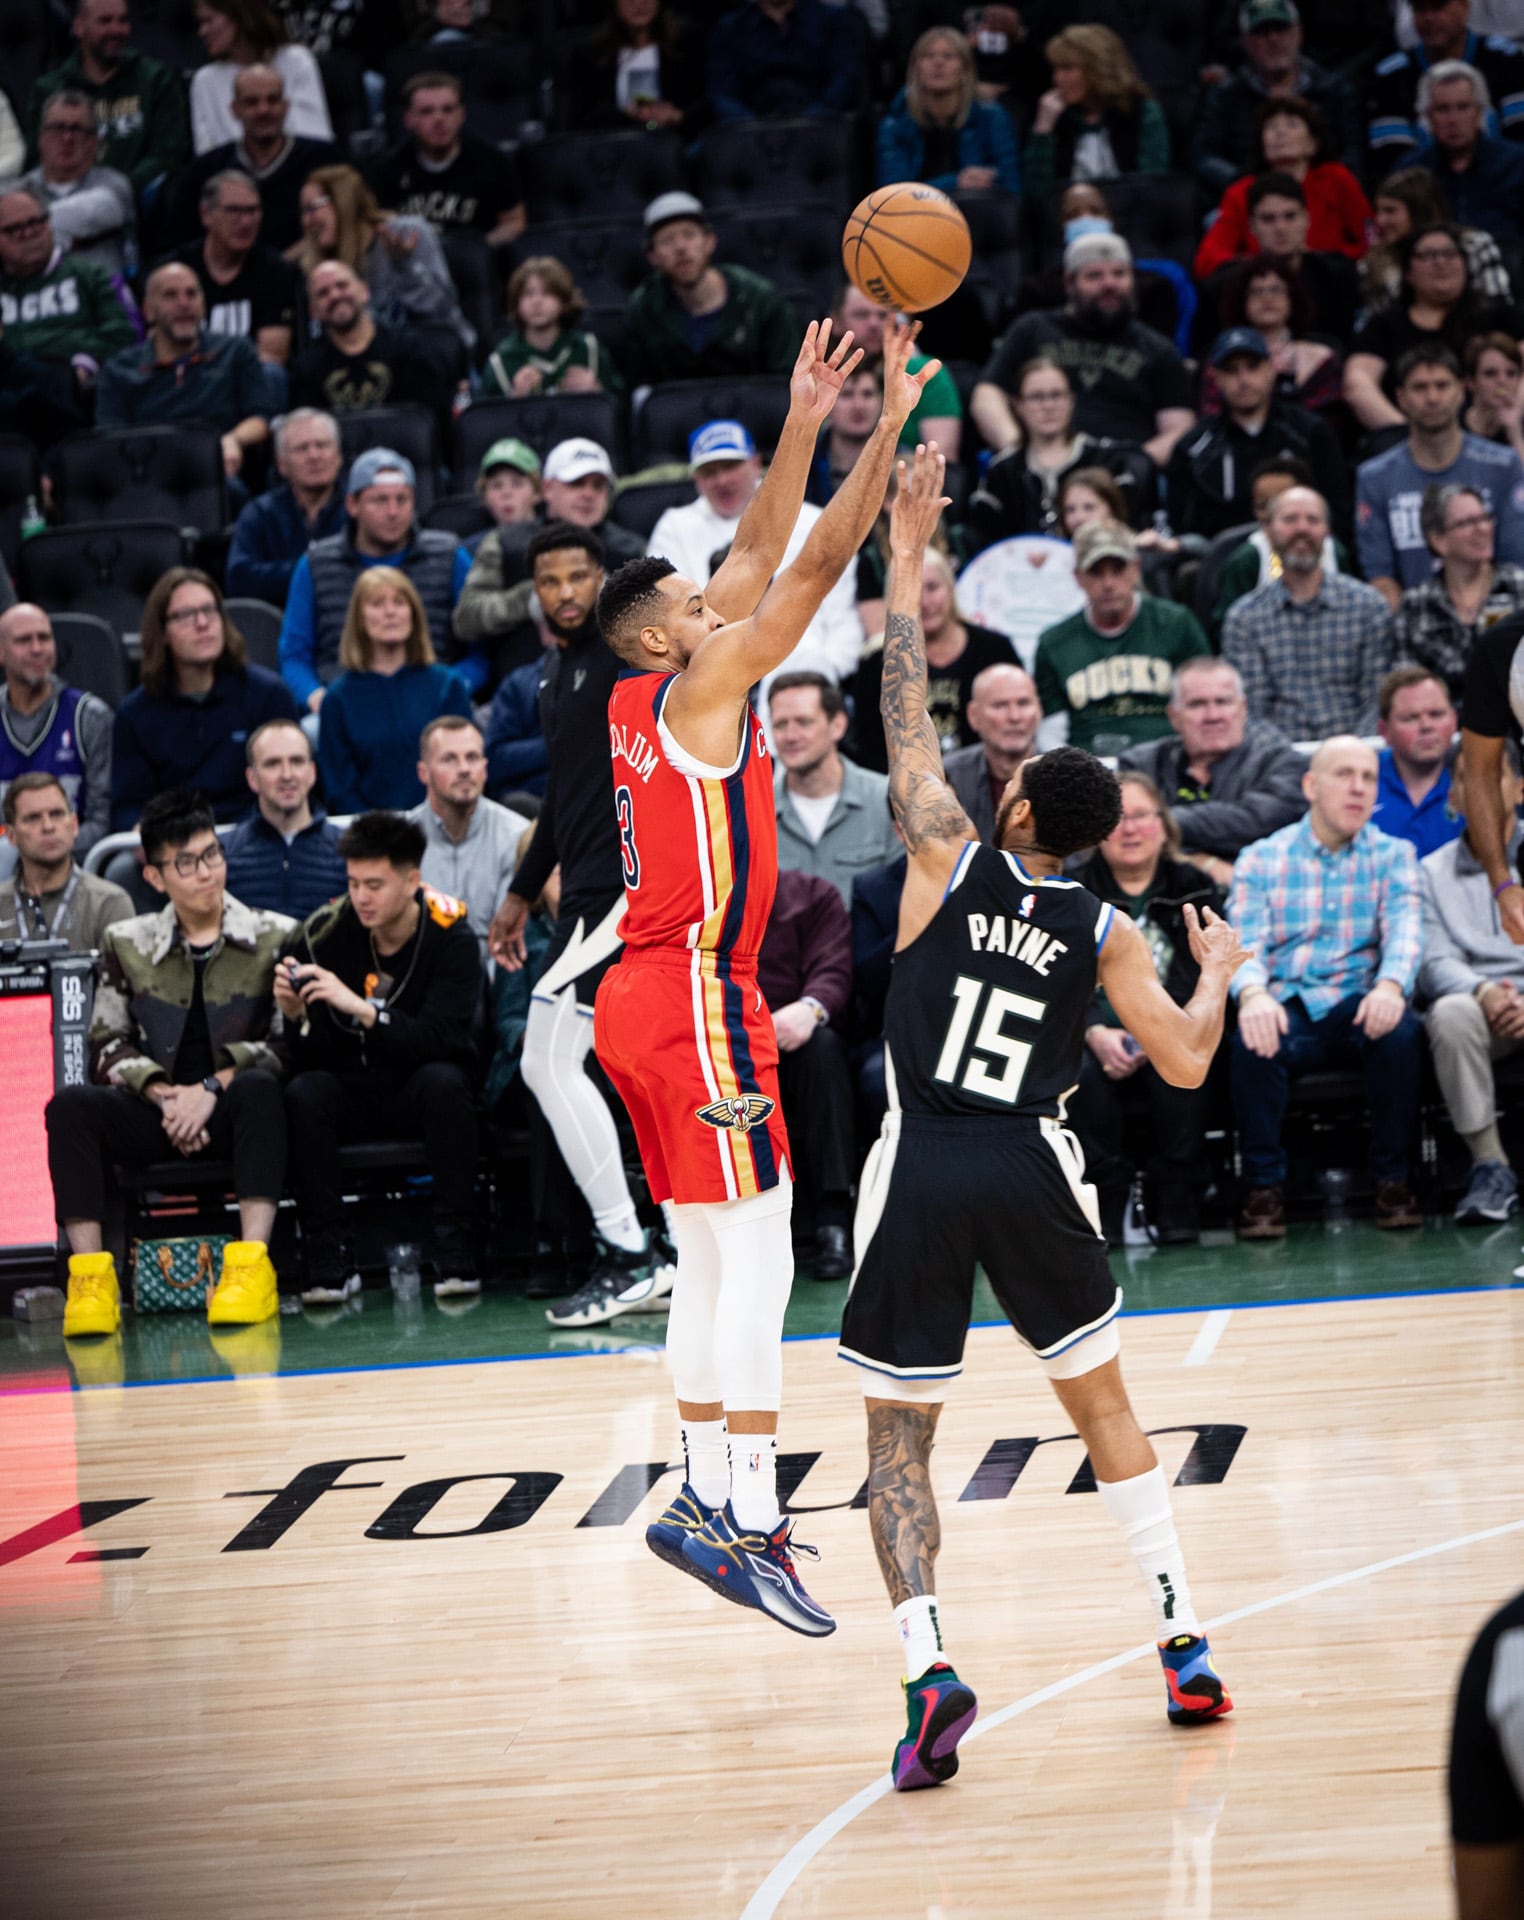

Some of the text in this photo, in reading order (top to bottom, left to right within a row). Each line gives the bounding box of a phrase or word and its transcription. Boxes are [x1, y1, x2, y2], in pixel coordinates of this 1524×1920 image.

[1066, 654, 1172, 711] BUCKS
[615, 784, 641, 891] 3
[967, 913, 1069, 976] PAYNE
[932, 973, 1048, 1105] 15
